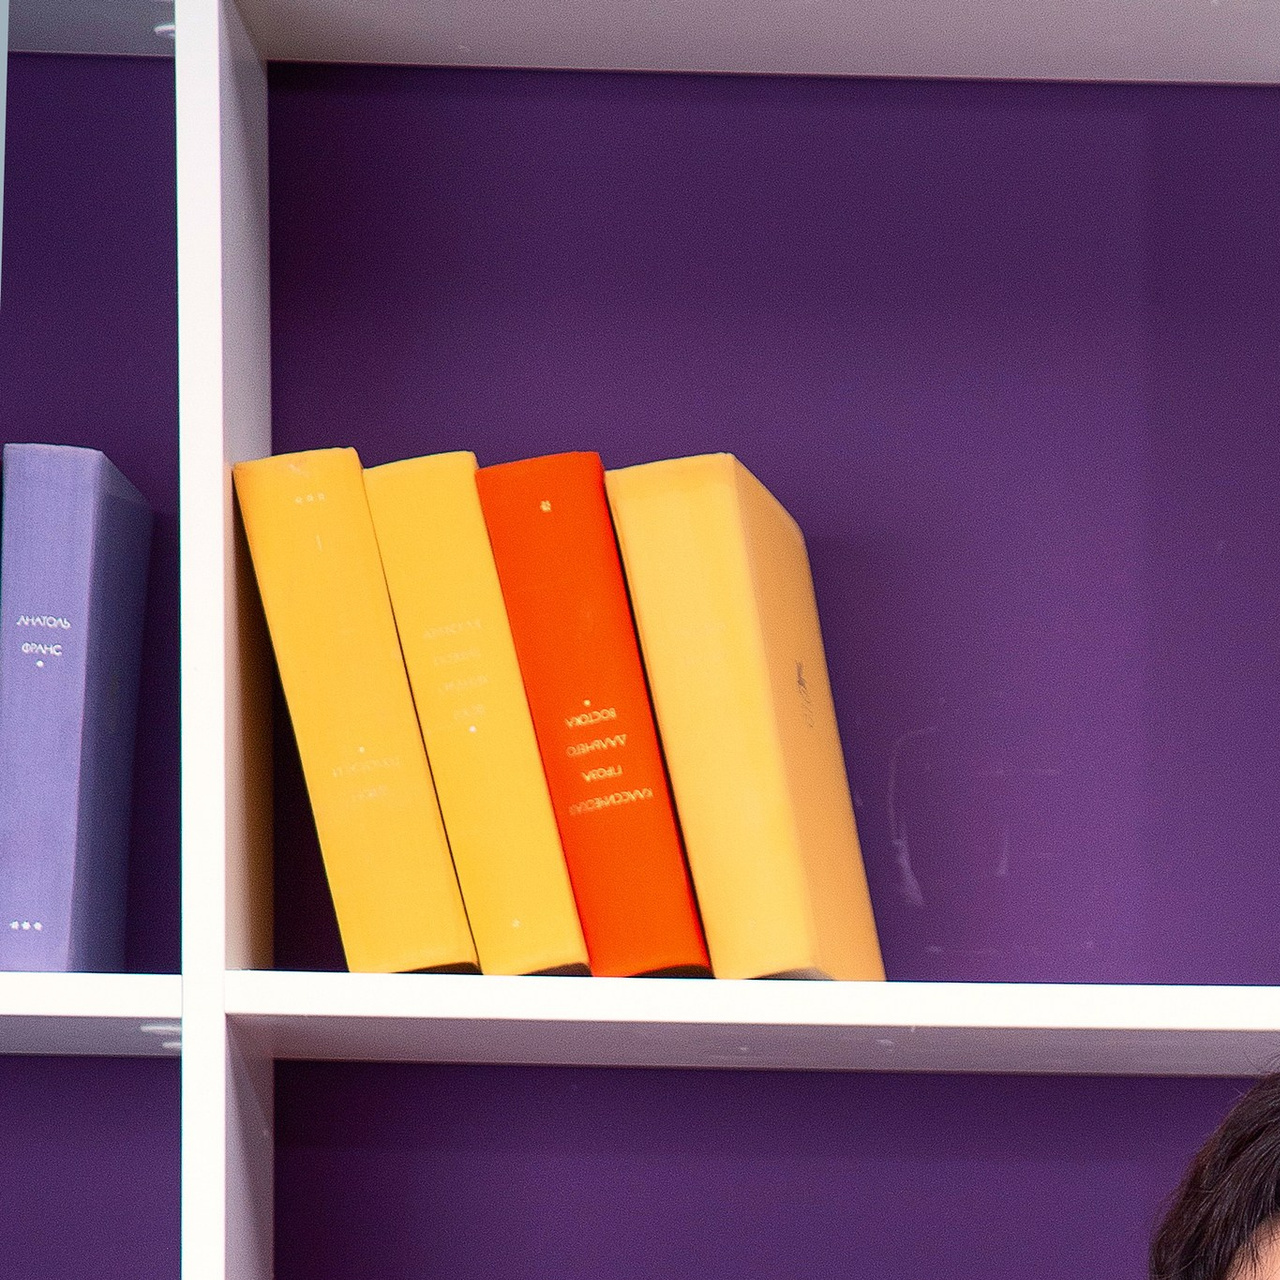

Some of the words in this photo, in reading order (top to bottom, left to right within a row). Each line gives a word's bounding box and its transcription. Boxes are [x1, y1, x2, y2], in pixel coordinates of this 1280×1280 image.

[16, 614, 71, 630] АНАТОЛЬ
[21, 642, 63, 657] ФРАНС
[565, 708, 617, 729] ВОСТОКА
[566, 734, 627, 757] ДАЛЬНЕГО
[581, 764, 623, 782] ПРОЗА
